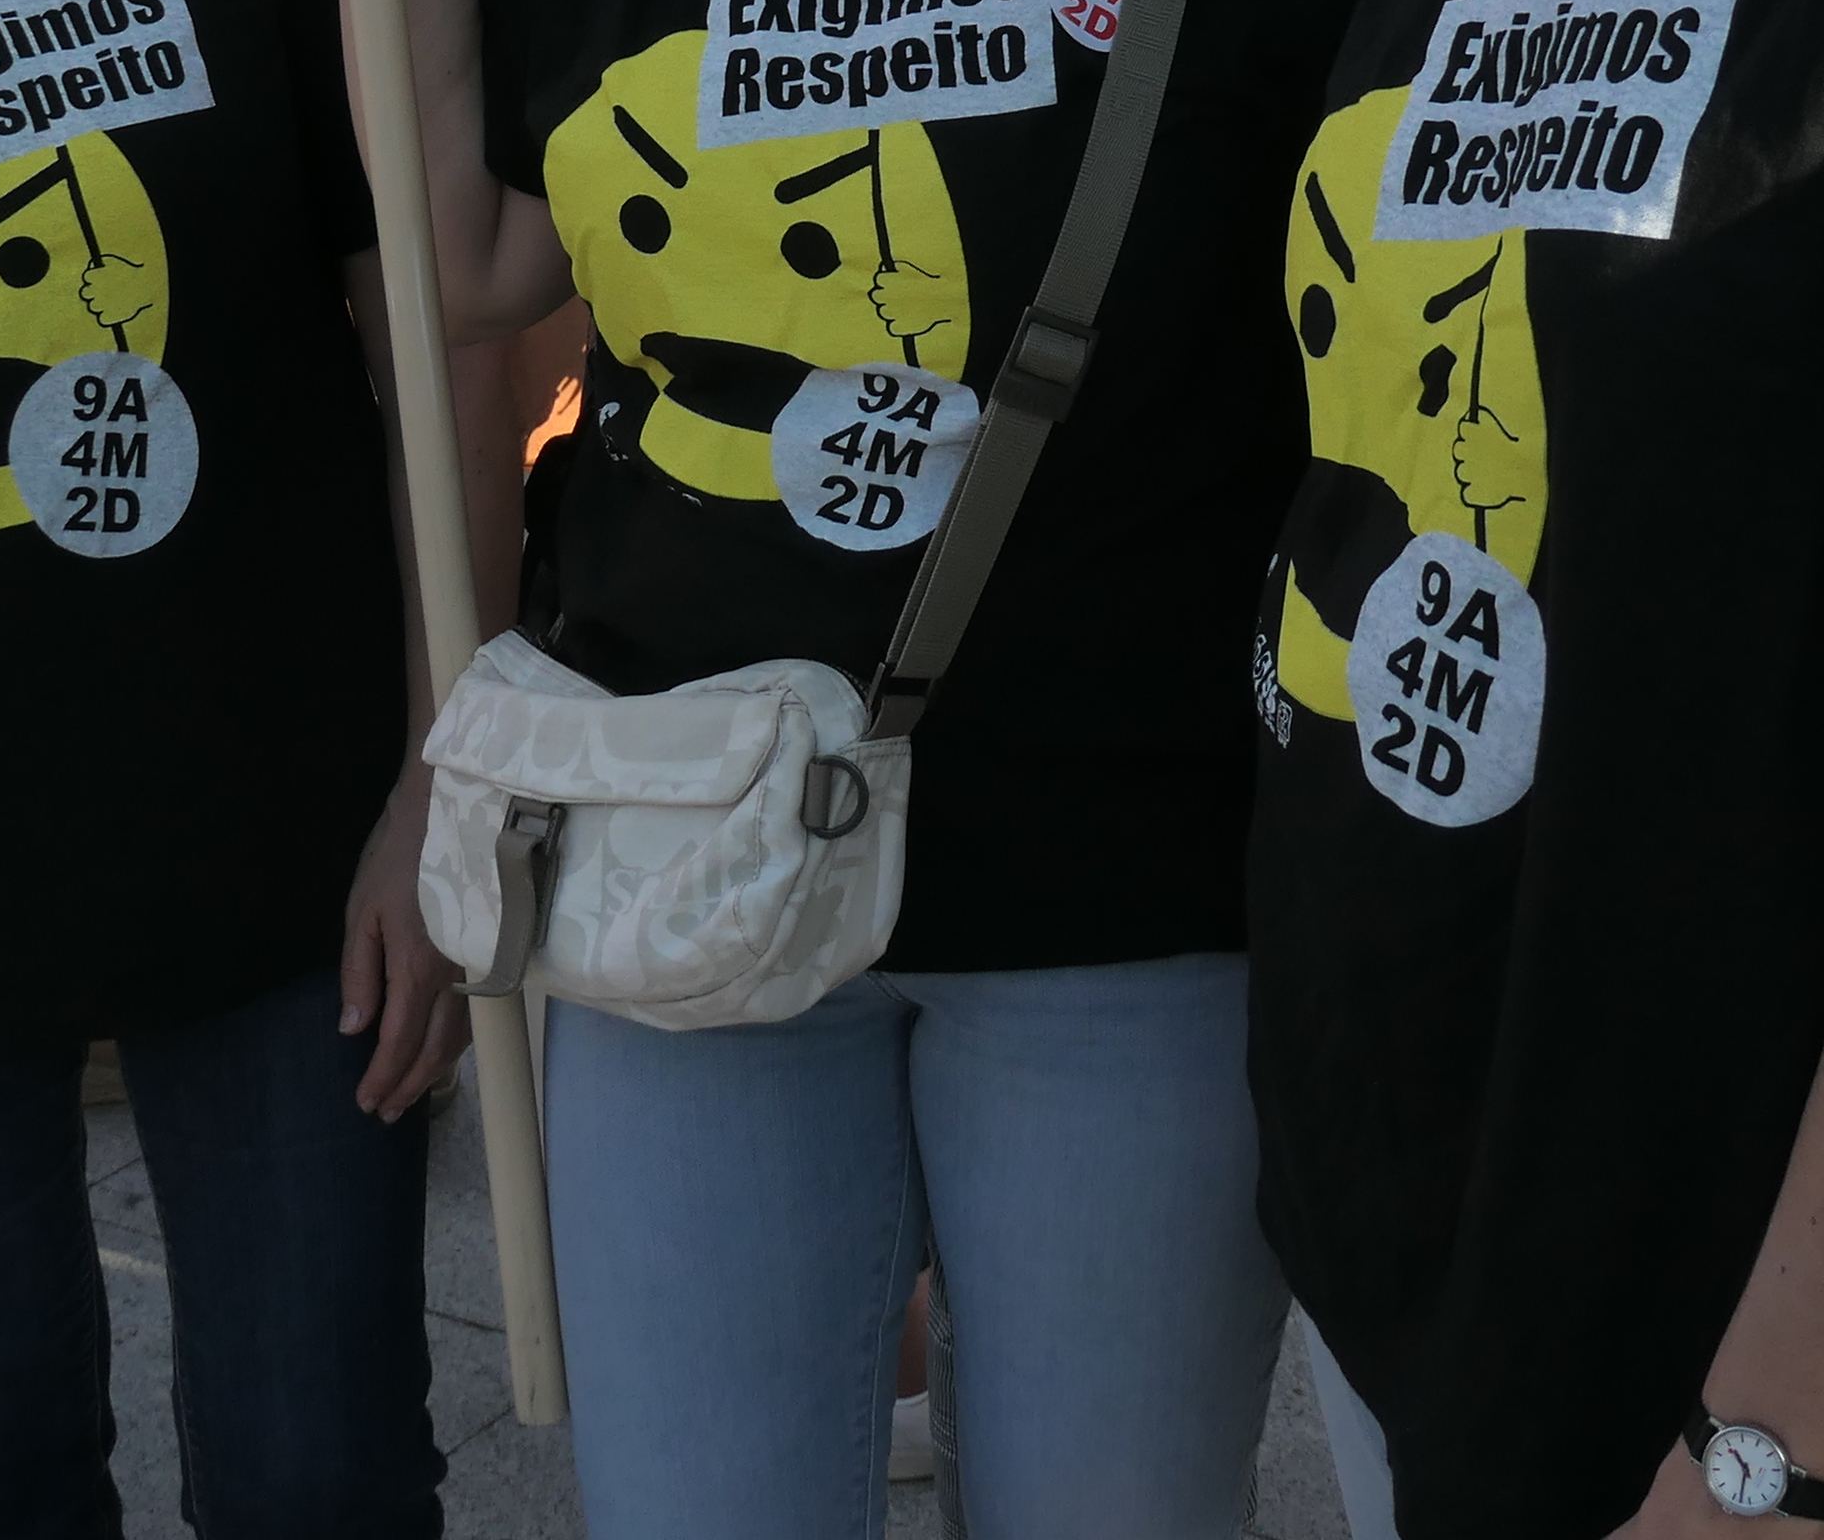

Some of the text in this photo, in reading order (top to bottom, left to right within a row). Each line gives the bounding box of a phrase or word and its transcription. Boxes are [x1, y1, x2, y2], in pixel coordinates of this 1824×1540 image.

[721, 21, 1027, 118] Respeito
[1429, 1, 1702, 108] Exigimos
[1402, 98, 1665, 209] Respeito
[72, 375, 150, 423] 9A
[857, 371, 941, 431] 9A
[60, 431, 149, 479] 4M
[820, 422, 925, 479] 4M
[64, 487, 141, 535] 2D
[816, 475, 905, 531] 2D
[1415, 559, 1502, 662] 9A
[1385, 636, 1495, 735] 4M
[1369, 704, 1468, 799] 2D
